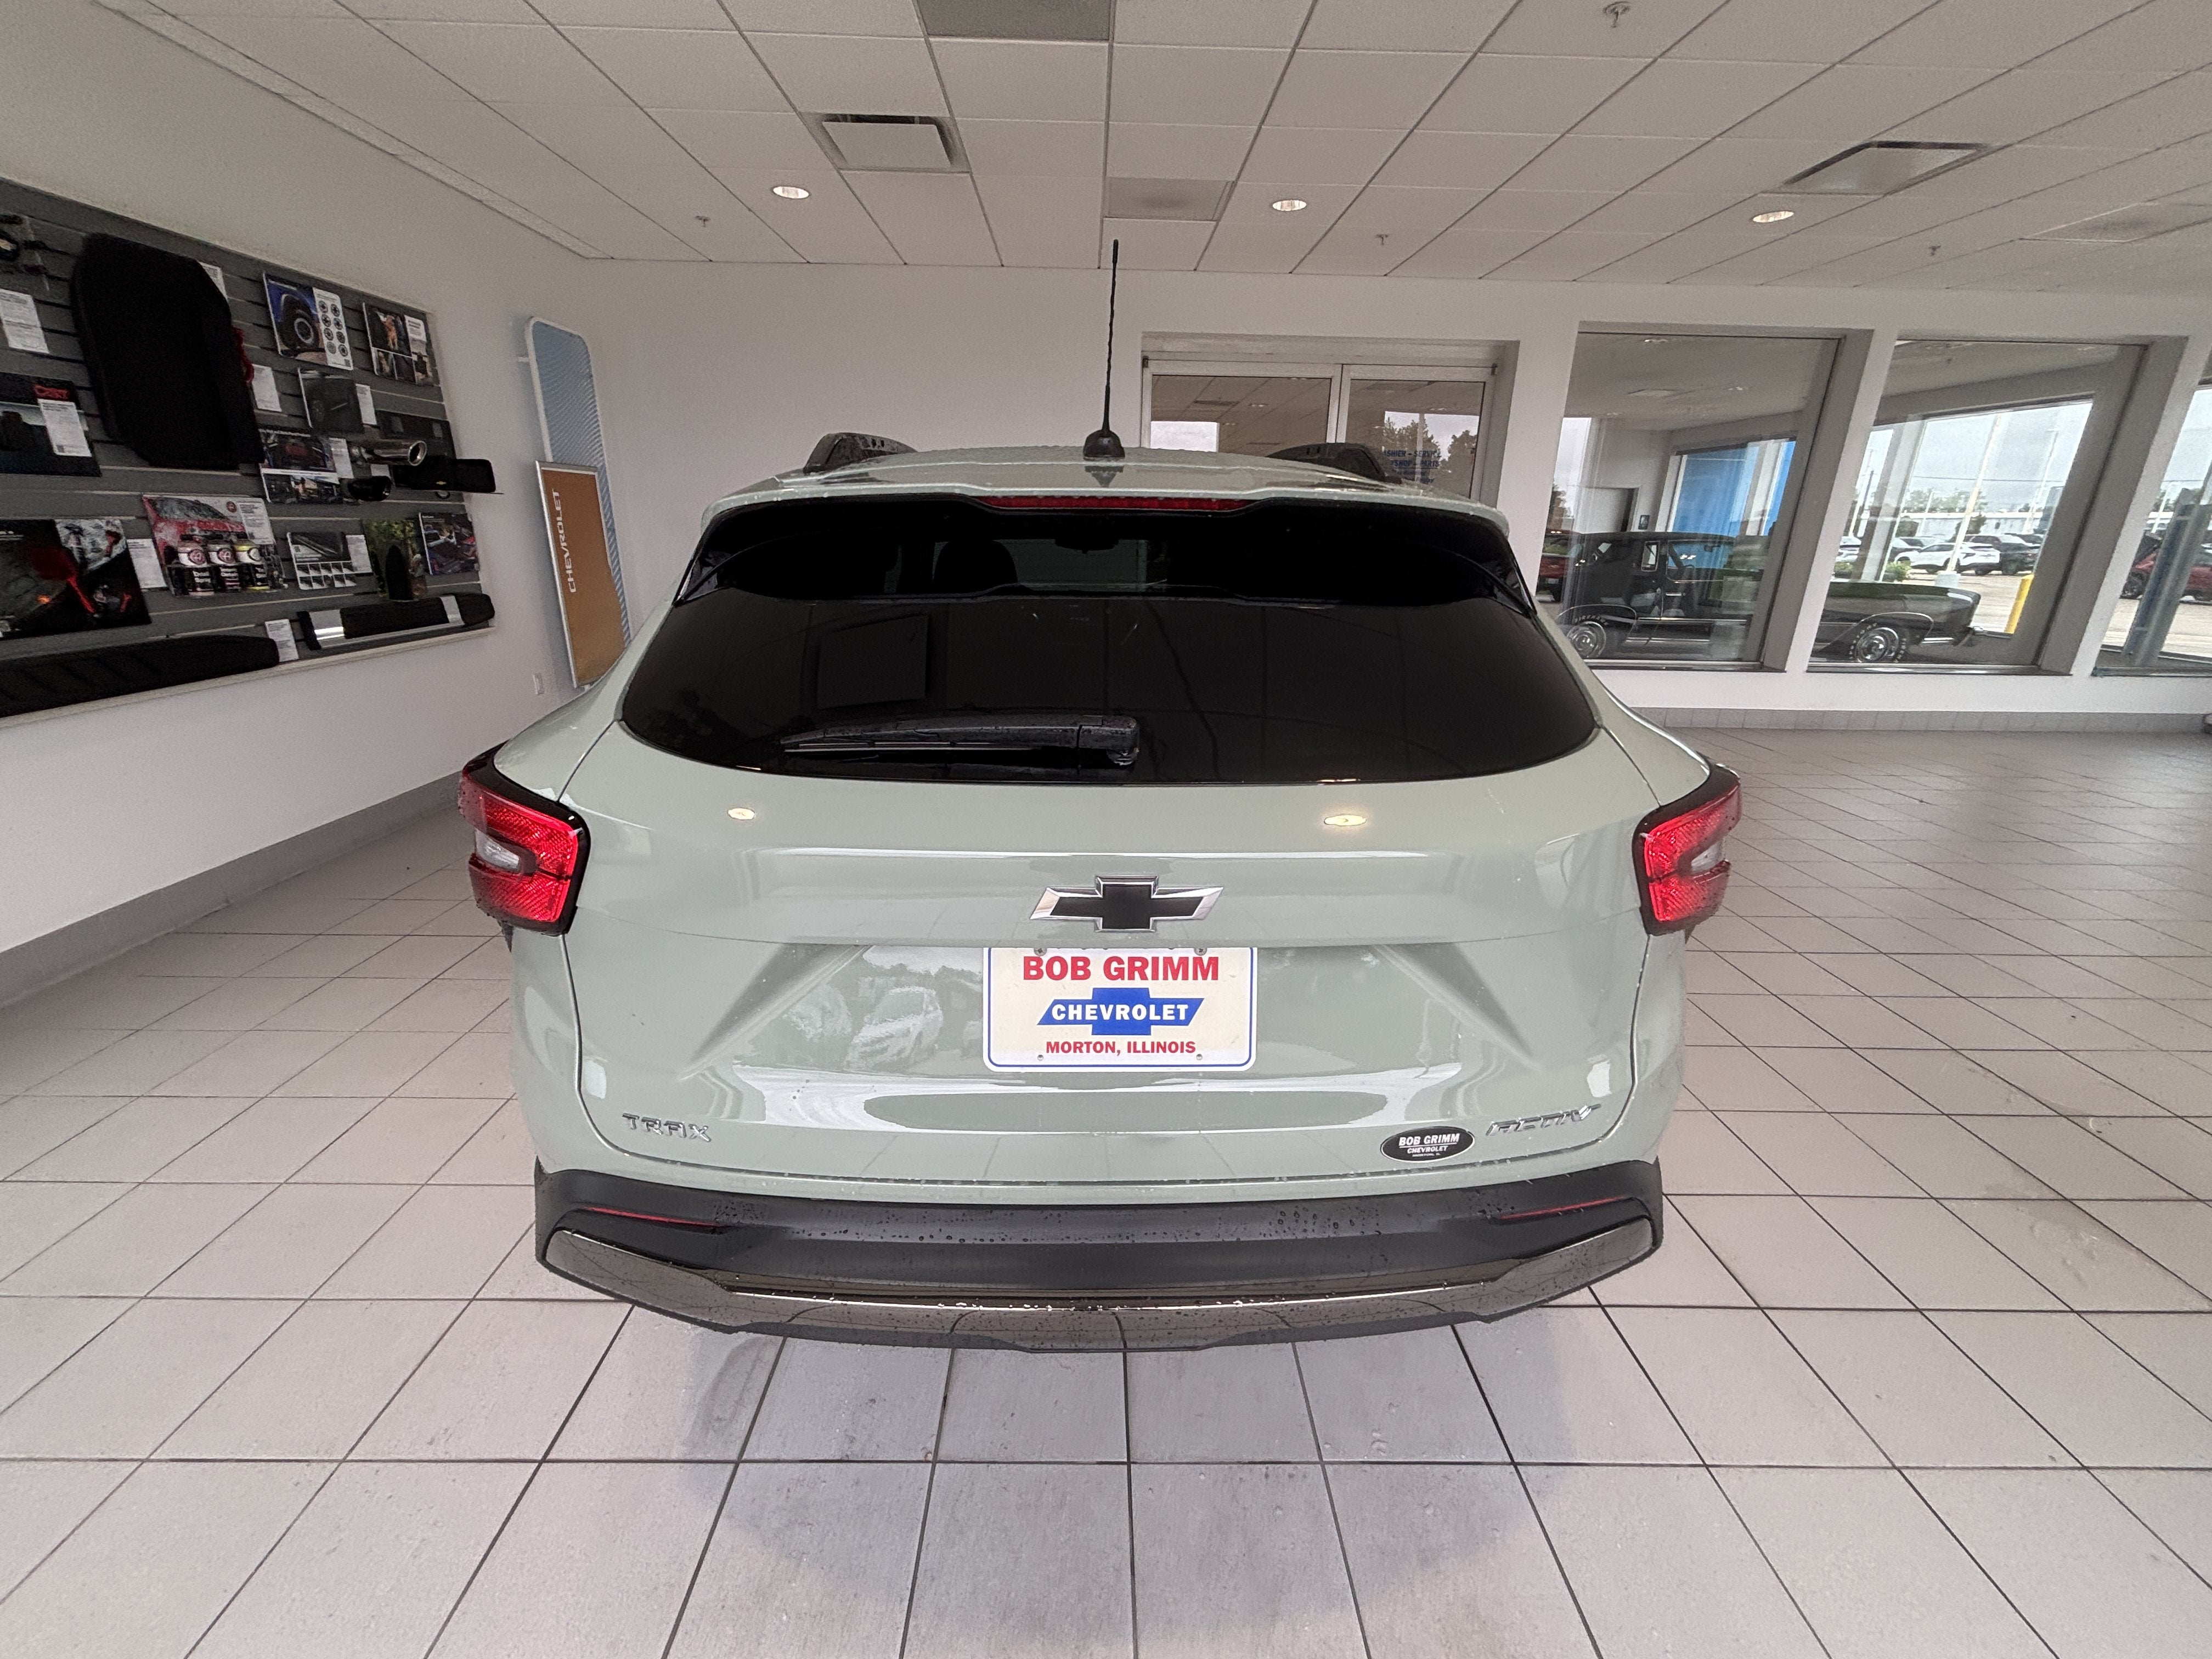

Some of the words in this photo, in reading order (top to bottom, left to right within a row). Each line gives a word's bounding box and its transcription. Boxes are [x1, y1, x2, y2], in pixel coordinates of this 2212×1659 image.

[552, 489, 576, 593] CHEVROLET
[1023, 956, 1091, 981] BOB
[1103, 956, 1219, 981] GRIMM
[1052, 1003, 1189, 1021] CHEVROLET
[1046, 1041, 1121, 1056] MORTON,
[1127, 1041, 1196, 1053] ILLINOIS
[622, 1113, 712, 1143] TRAX
[1398, 1136, 1421, 1146] BOB
[1423, 1133, 1460, 1144] GRIMM
[1407, 1145, 1449, 1154] CHEVROLET
